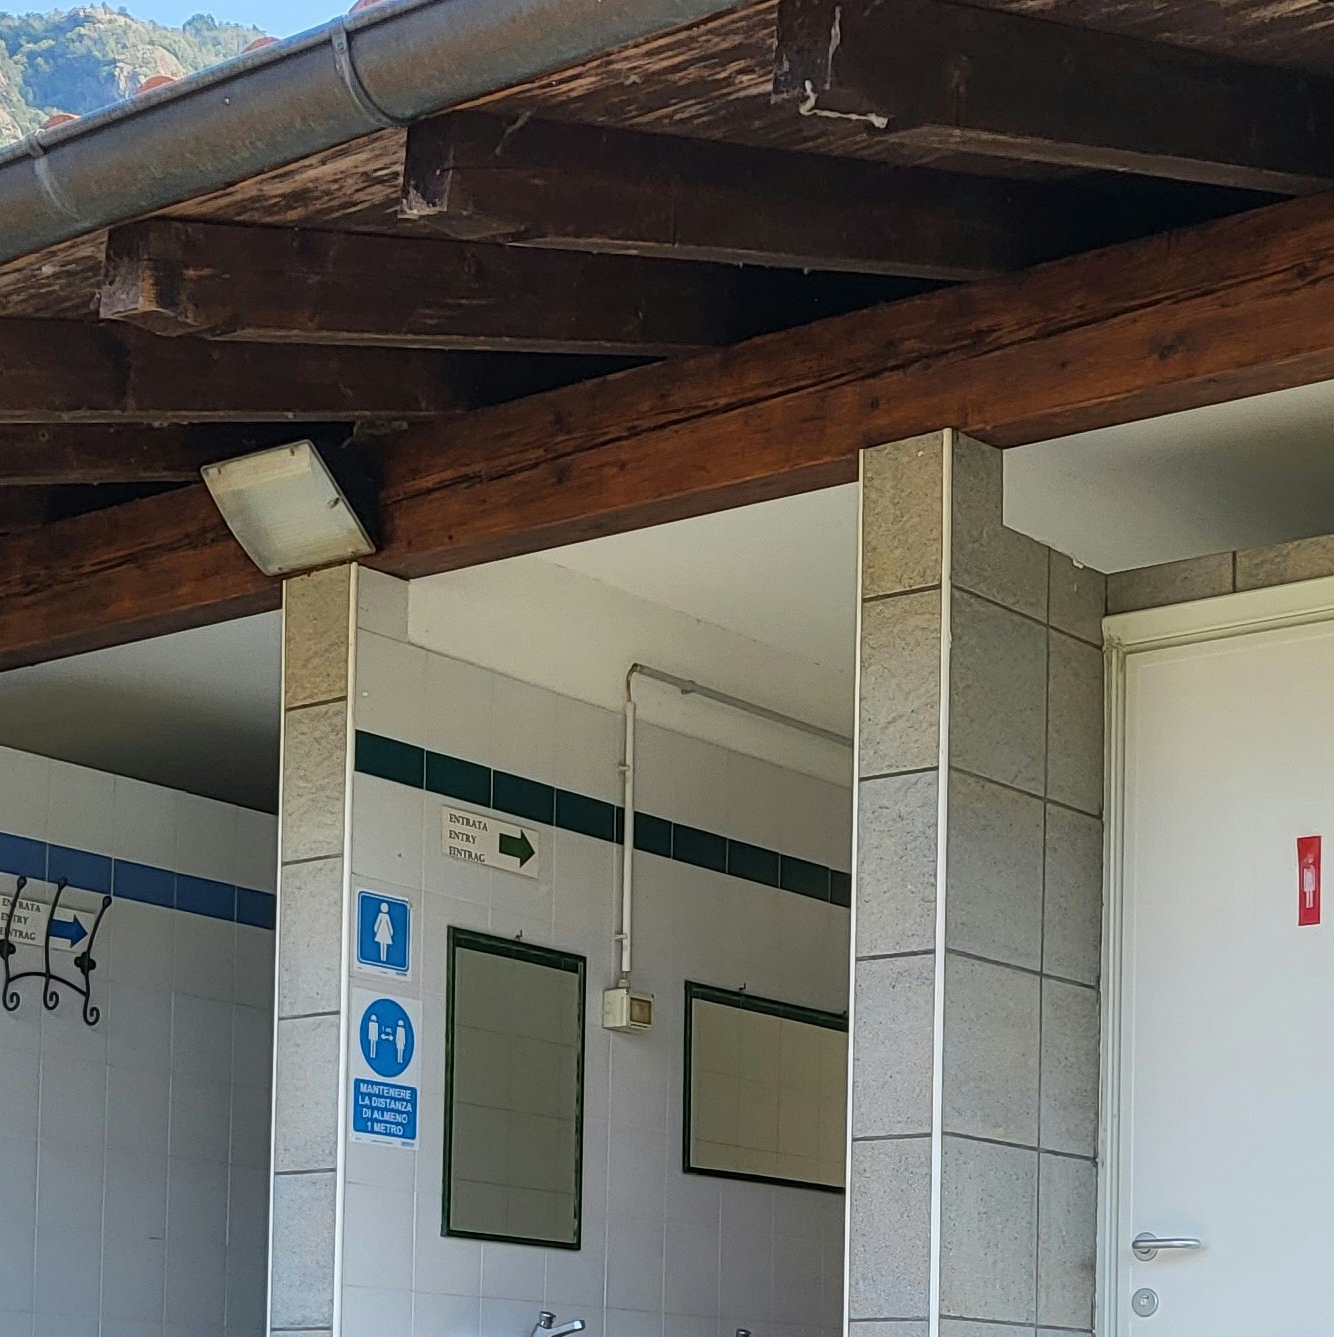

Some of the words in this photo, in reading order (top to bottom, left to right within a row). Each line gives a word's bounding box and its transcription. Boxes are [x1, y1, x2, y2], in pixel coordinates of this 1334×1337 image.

[449, 813, 488, 832] ENTRATA
[449, 829, 477, 845] ENTRY
[449, 846, 485, 862] EINTRAG
[2, 898, 41, 913] ERATA
[0, 927, 36, 940] ENTRAG
[360, 1082, 412, 1100] MANTENERE
[358, 1094, 370, 1105] LA
[371, 1096, 413, 1113] DISTANZA
[362, 1107, 371, 1118] DI
[372, 1109, 408, 1124] ALMENO
[367, 1121, 371, 1131] 1
[373, 1122, 404, 1136] METRO
